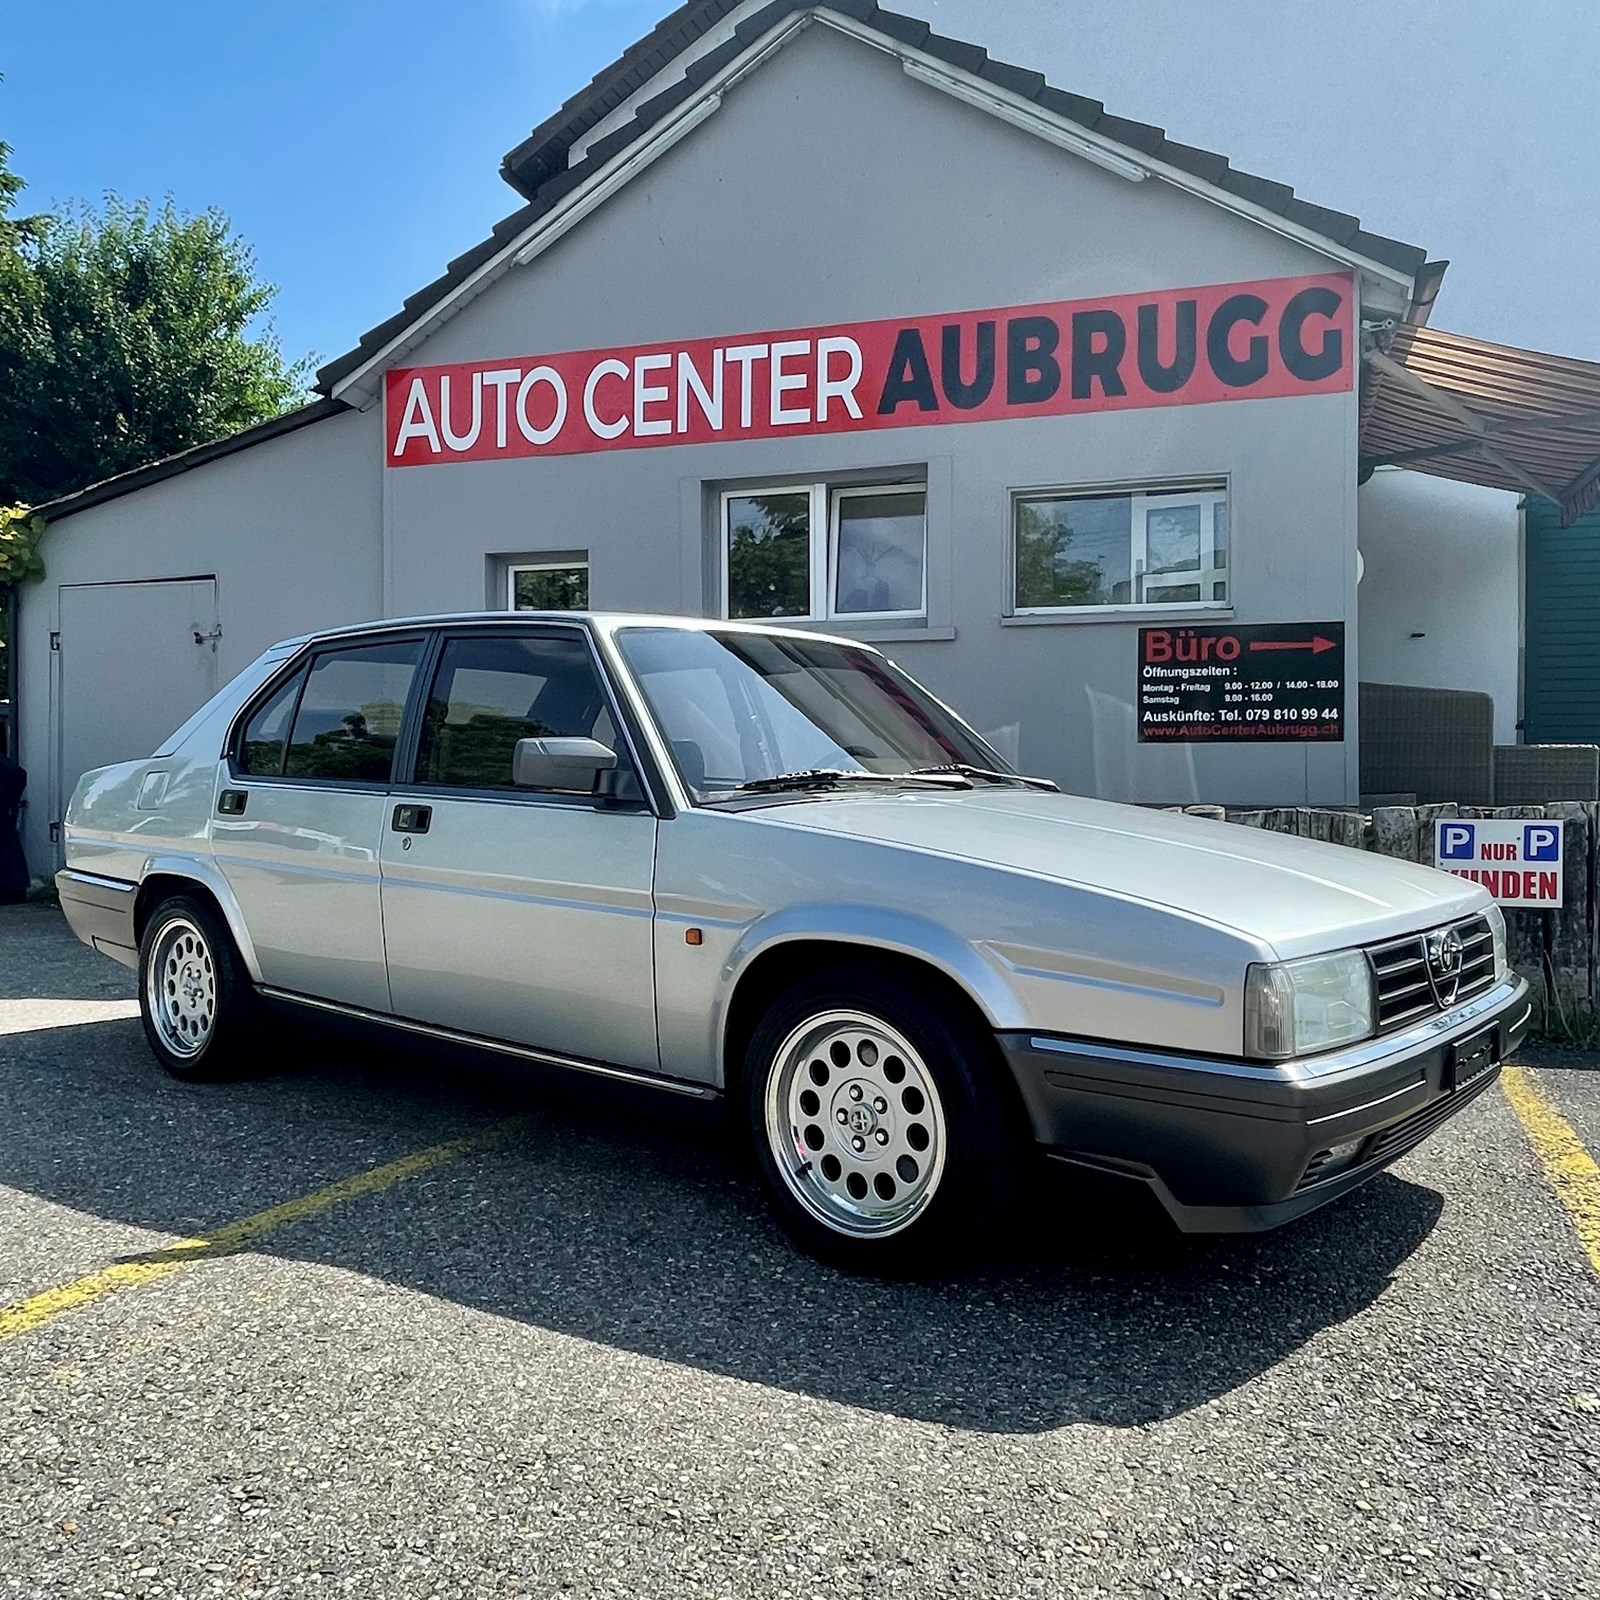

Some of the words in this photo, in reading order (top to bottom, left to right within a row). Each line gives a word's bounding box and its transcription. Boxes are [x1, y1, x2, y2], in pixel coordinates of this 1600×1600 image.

[393, 365, 568, 457] AUTO
[582, 336, 866, 441] CENTER
[876, 287, 1345, 416] AUBRUGG
[1145, 629, 1241, 662] Büro
[1142, 665, 1230, 679] Öffnungszeiten
[1142, 683, 1174, 693] Montag
[1180, 682, 1211, 693] Freitag
[1224, 681, 1243, 691] 9.00
[1250, 681, 1273, 690] 12.00
[1285, 680, 1308, 689] 14.00
[1142, 695, 1180, 705] Samstag
[1142, 709, 1216, 722] Auskünfte:
[1218, 709, 1242, 721] Tel.
[1245, 708, 1270, 721] 079
[1273, 708, 1298, 720] 810
[1300, 708, 1318, 720] 99
[1321, 707, 1339, 720] 44
[1143, 723, 1339, 737] www.AutoCenterAubrugg.ch
[1445, 827, 1470, 855] P
[1481, 843, 1518, 861] NUR
[1529, 829, 1554, 856] P
[1443, 869, 1557, 900] NDEN
